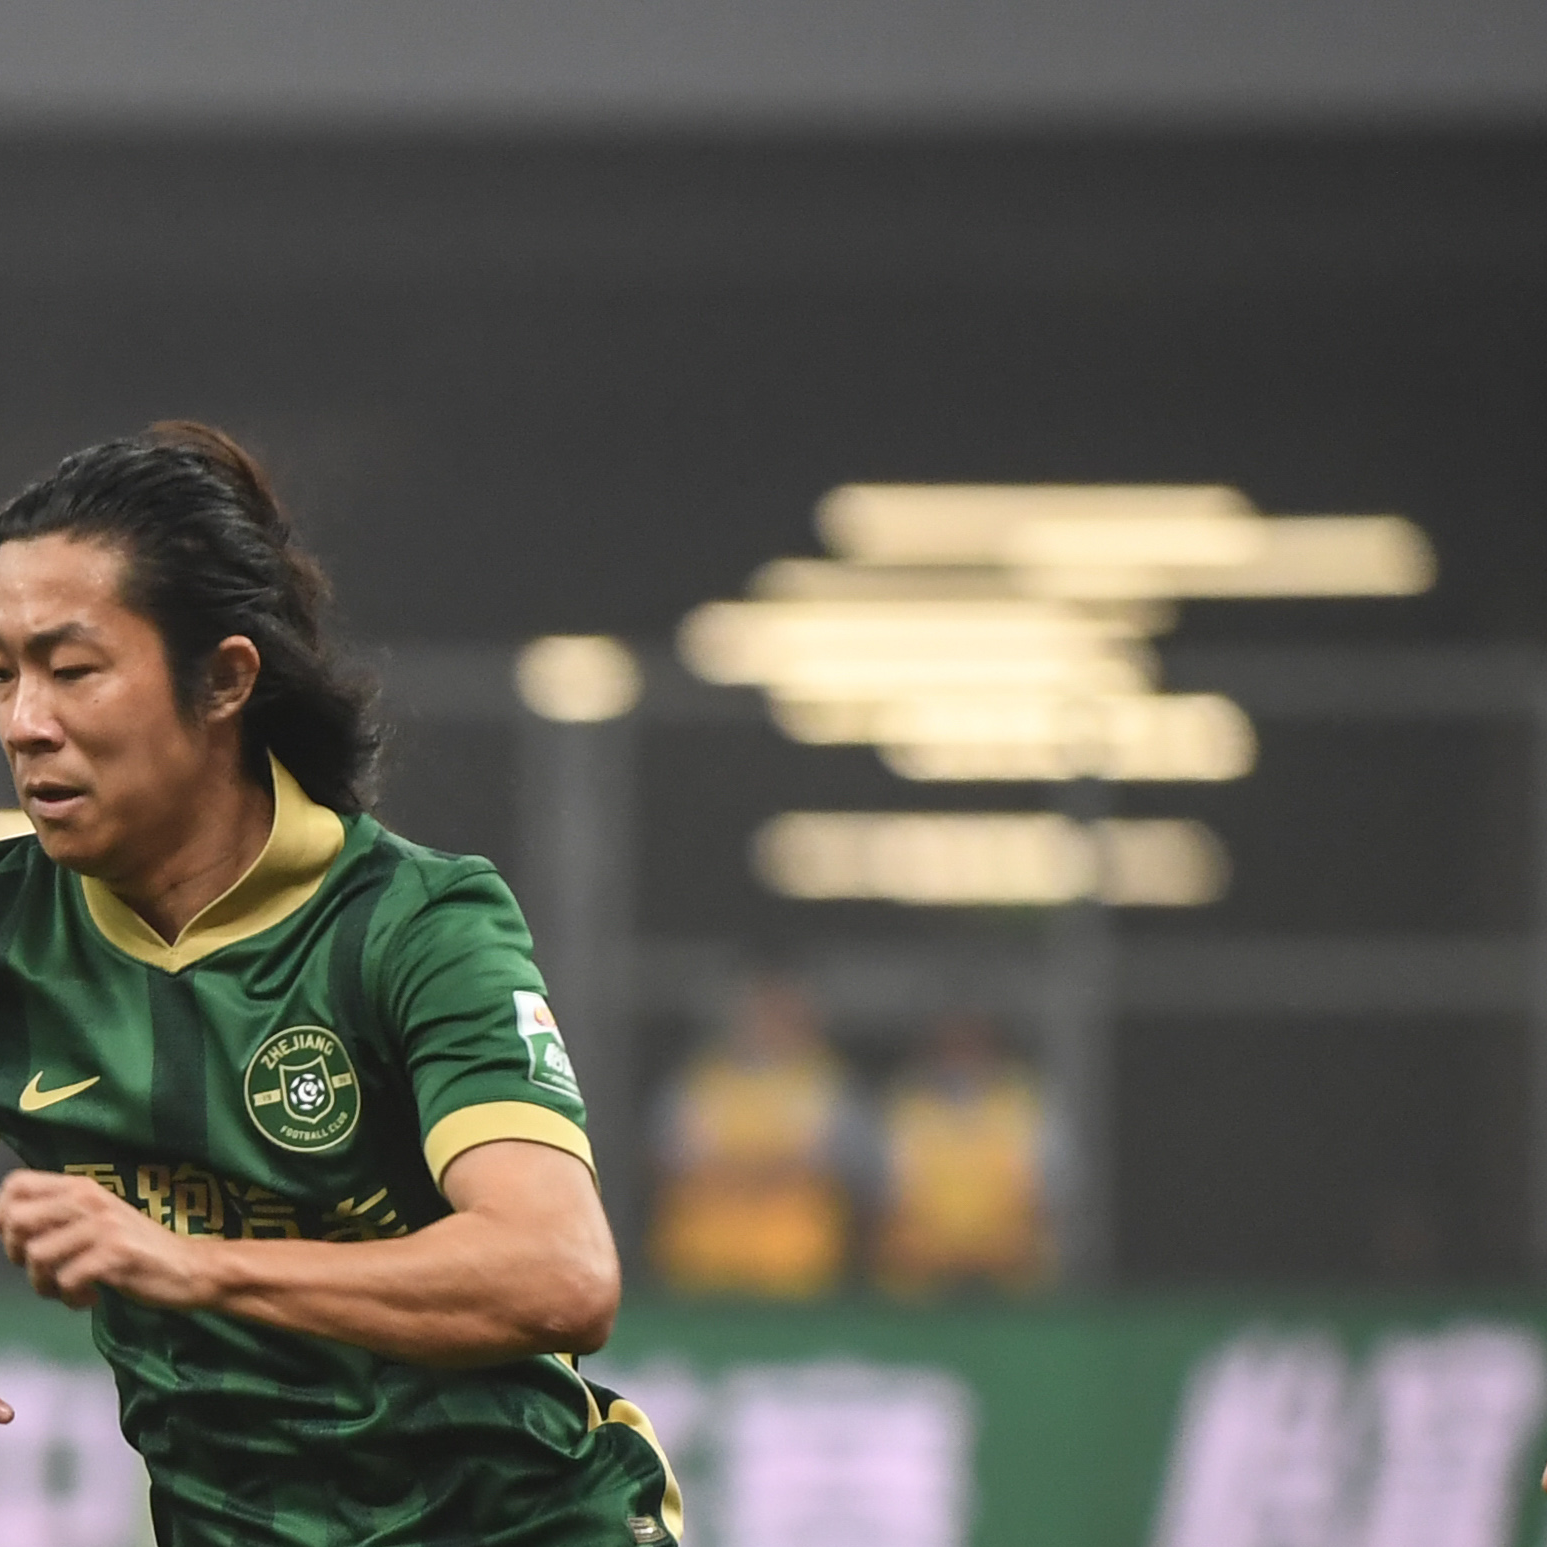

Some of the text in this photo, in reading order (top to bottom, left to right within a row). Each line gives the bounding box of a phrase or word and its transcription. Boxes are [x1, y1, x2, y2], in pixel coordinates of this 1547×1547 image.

[260, 1034, 334, 1070] ZHEJIANG
[279, 1111, 348, 1141] FOOTBALL CLUB
